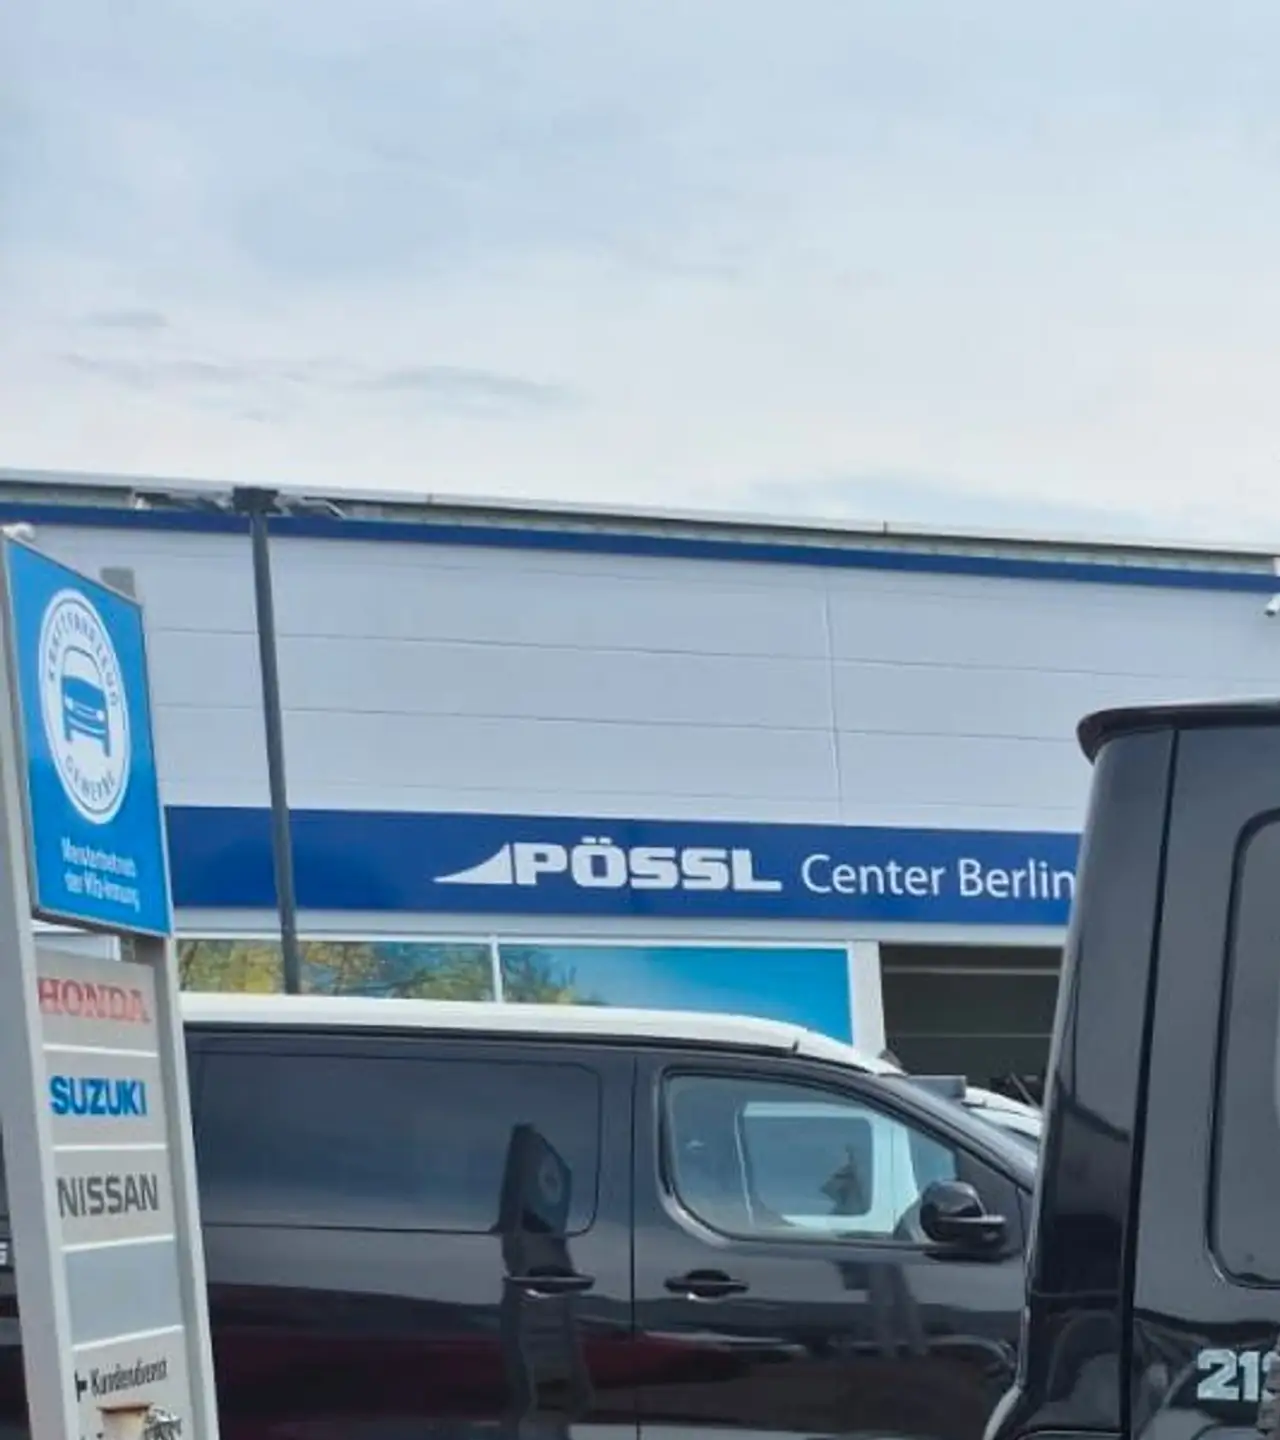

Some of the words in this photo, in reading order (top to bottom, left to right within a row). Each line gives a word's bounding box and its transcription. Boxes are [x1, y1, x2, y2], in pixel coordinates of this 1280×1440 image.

[513, 836, 783, 892] PÖSSL
[801, 853, 947, 896] Center
[958, 857, 1077, 899] Berlin
[37, 975, 152, 1023] HONDA
[49, 1075, 147, 1117] SUZUKI
[56, 1173, 160, 1218] NISSAN
